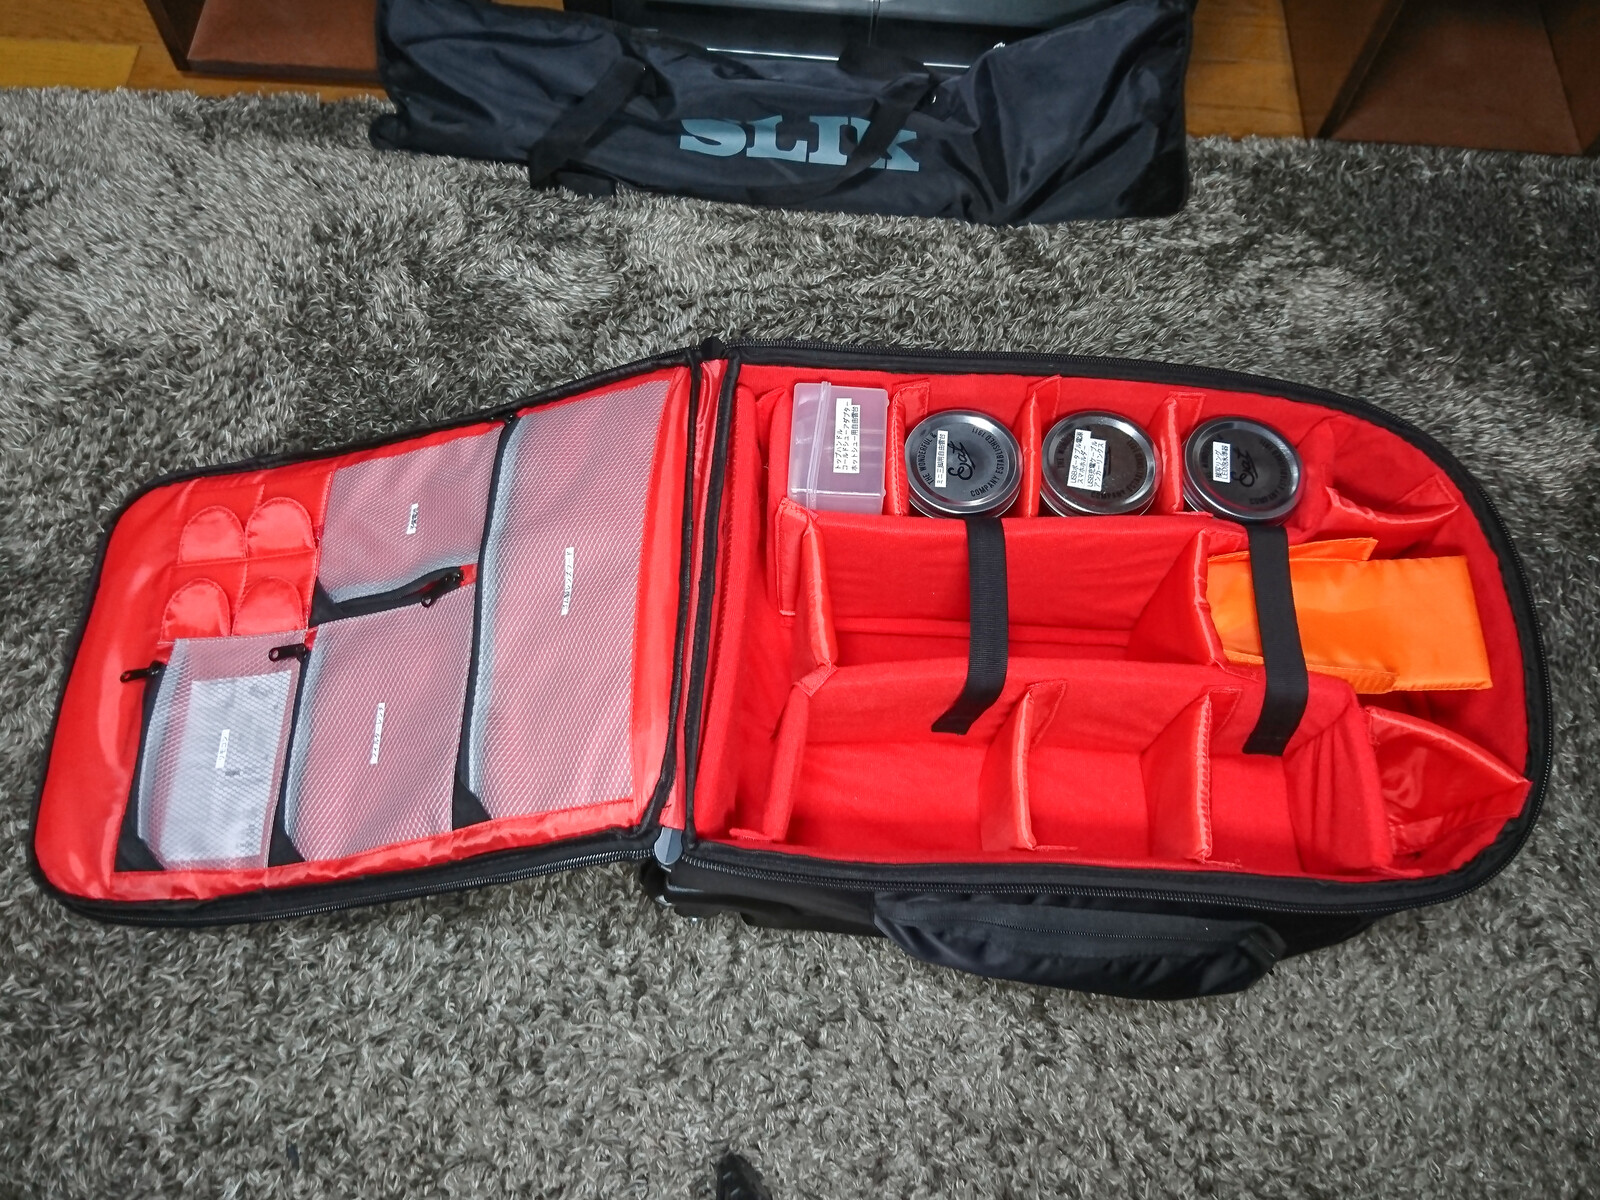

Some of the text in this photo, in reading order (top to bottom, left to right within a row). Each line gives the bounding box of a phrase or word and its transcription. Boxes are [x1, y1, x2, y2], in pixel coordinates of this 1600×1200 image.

[918, 437, 933, 472] WONDERFUL
[947, 441, 976, 481] Eat
[970, 475, 1000, 497] COMPANY
[985, 432, 1005, 475] ESTABLISHED
[922, 473, 934, 485] THE
